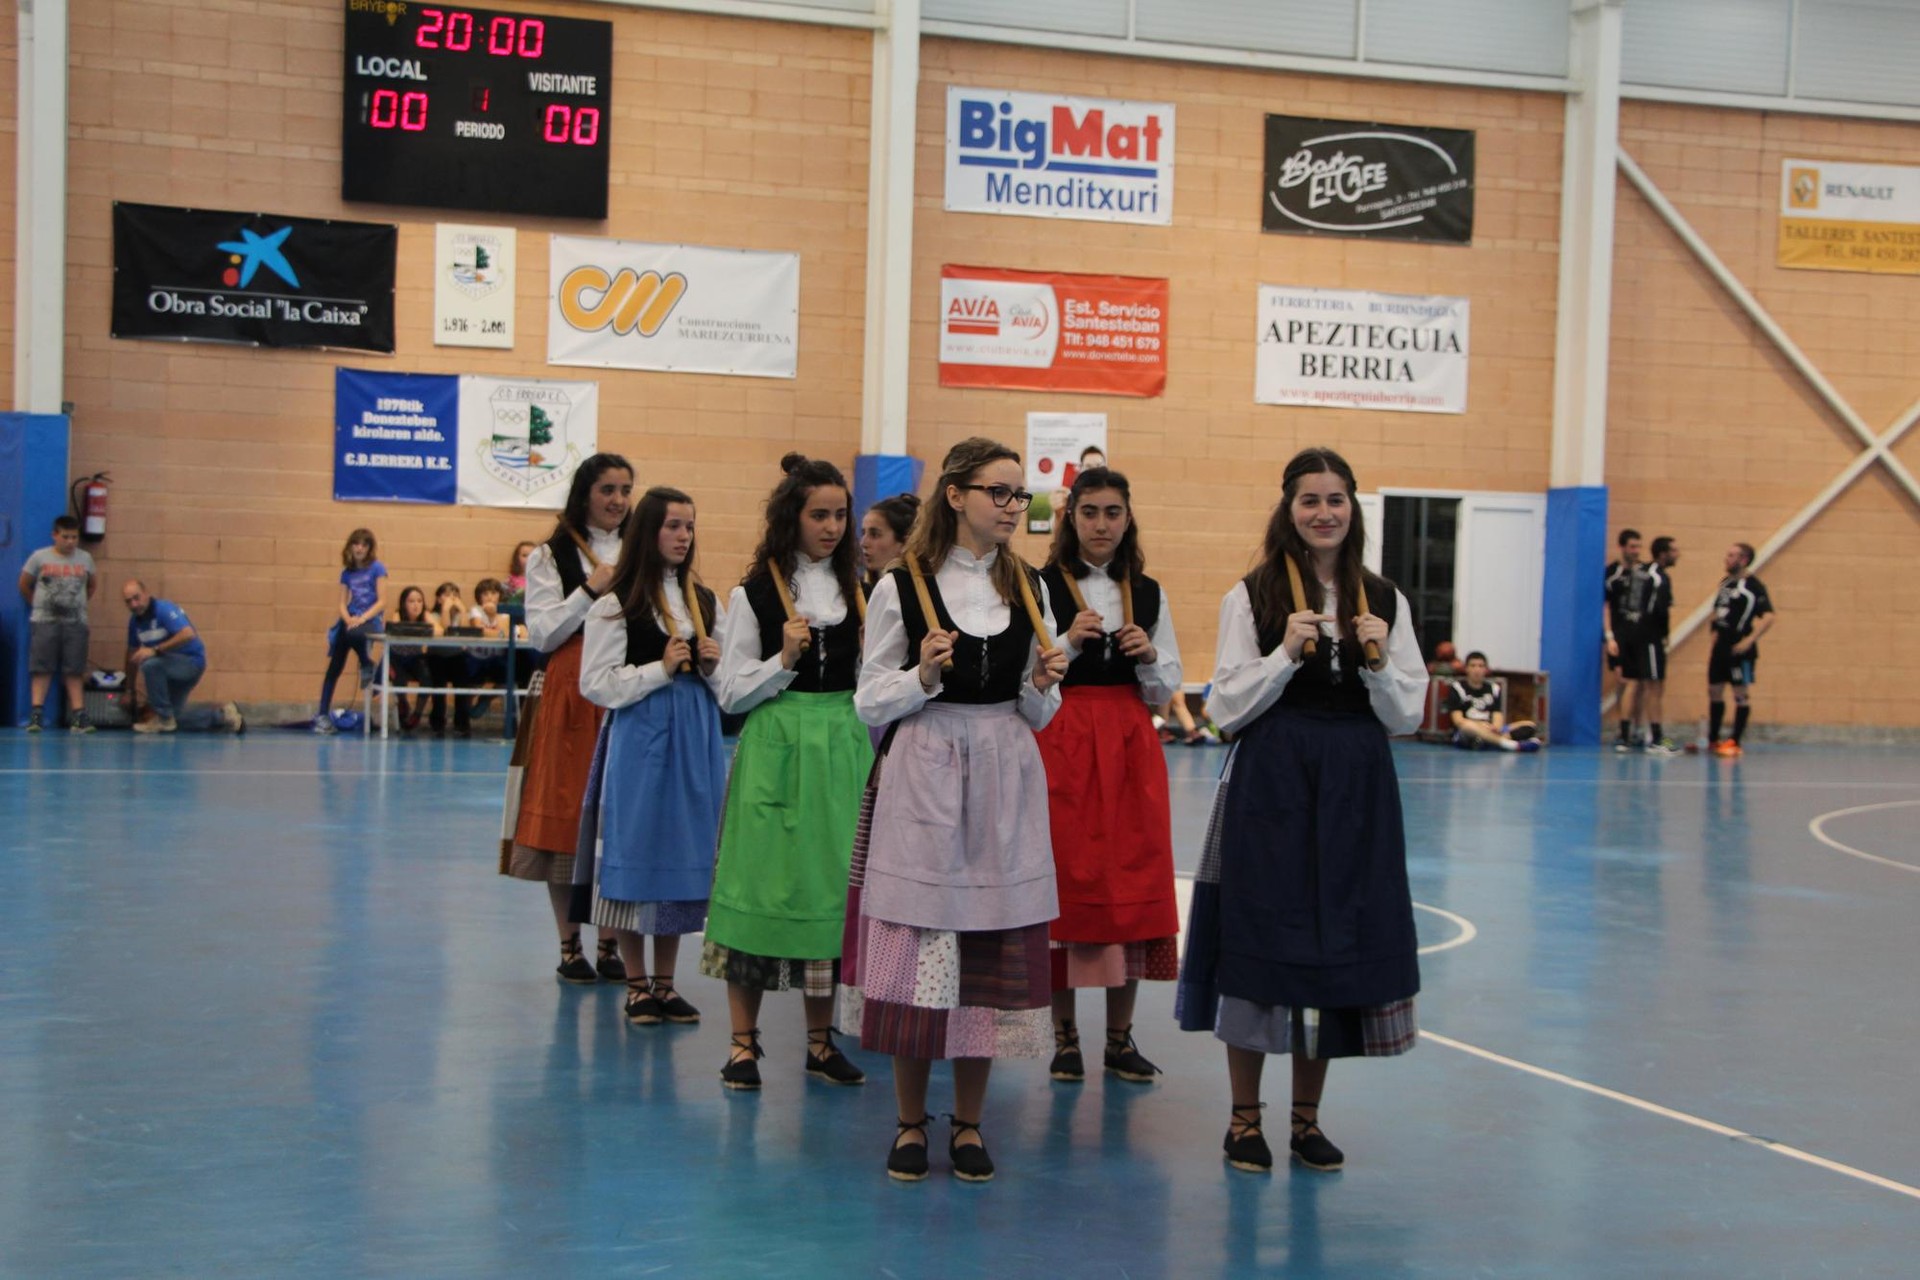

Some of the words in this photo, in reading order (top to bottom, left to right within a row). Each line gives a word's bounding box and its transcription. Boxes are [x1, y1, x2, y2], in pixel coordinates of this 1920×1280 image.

[415, 9, 545, 58] 20:00
[356, 55, 428, 81] LOCAL
[528, 72, 597, 95] VISITANTE
[370, 89, 428, 131] 00
[455, 120, 505, 140] PERIODO
[544, 104, 599, 145] 00
[959, 99, 1162, 170] BigMat
[986, 172, 1158, 213] Menditxuri
[1825, 184, 1895, 200] RENAULT
[1786, 225, 1857, 241] TALLERES
[149, 290, 205, 316] Obra
[210, 295, 271, 319] Social
[1064, 298, 1094, 315] Est.
[1098, 300, 1161, 319] Servicio
[1271, 296, 1354, 311] FERRETERIA
[481, 318, 506, 334] 2.001
[678, 315, 762, 331] Construcciones
[1064, 314, 1161, 334] Santesteban
[1086, 333, 1110, 347] 948
[1263, 319, 1462, 353] APEZTEGUIA
[1300, 353, 1415, 382] BERRIA
[352, 425, 411, 440] kirolaren
